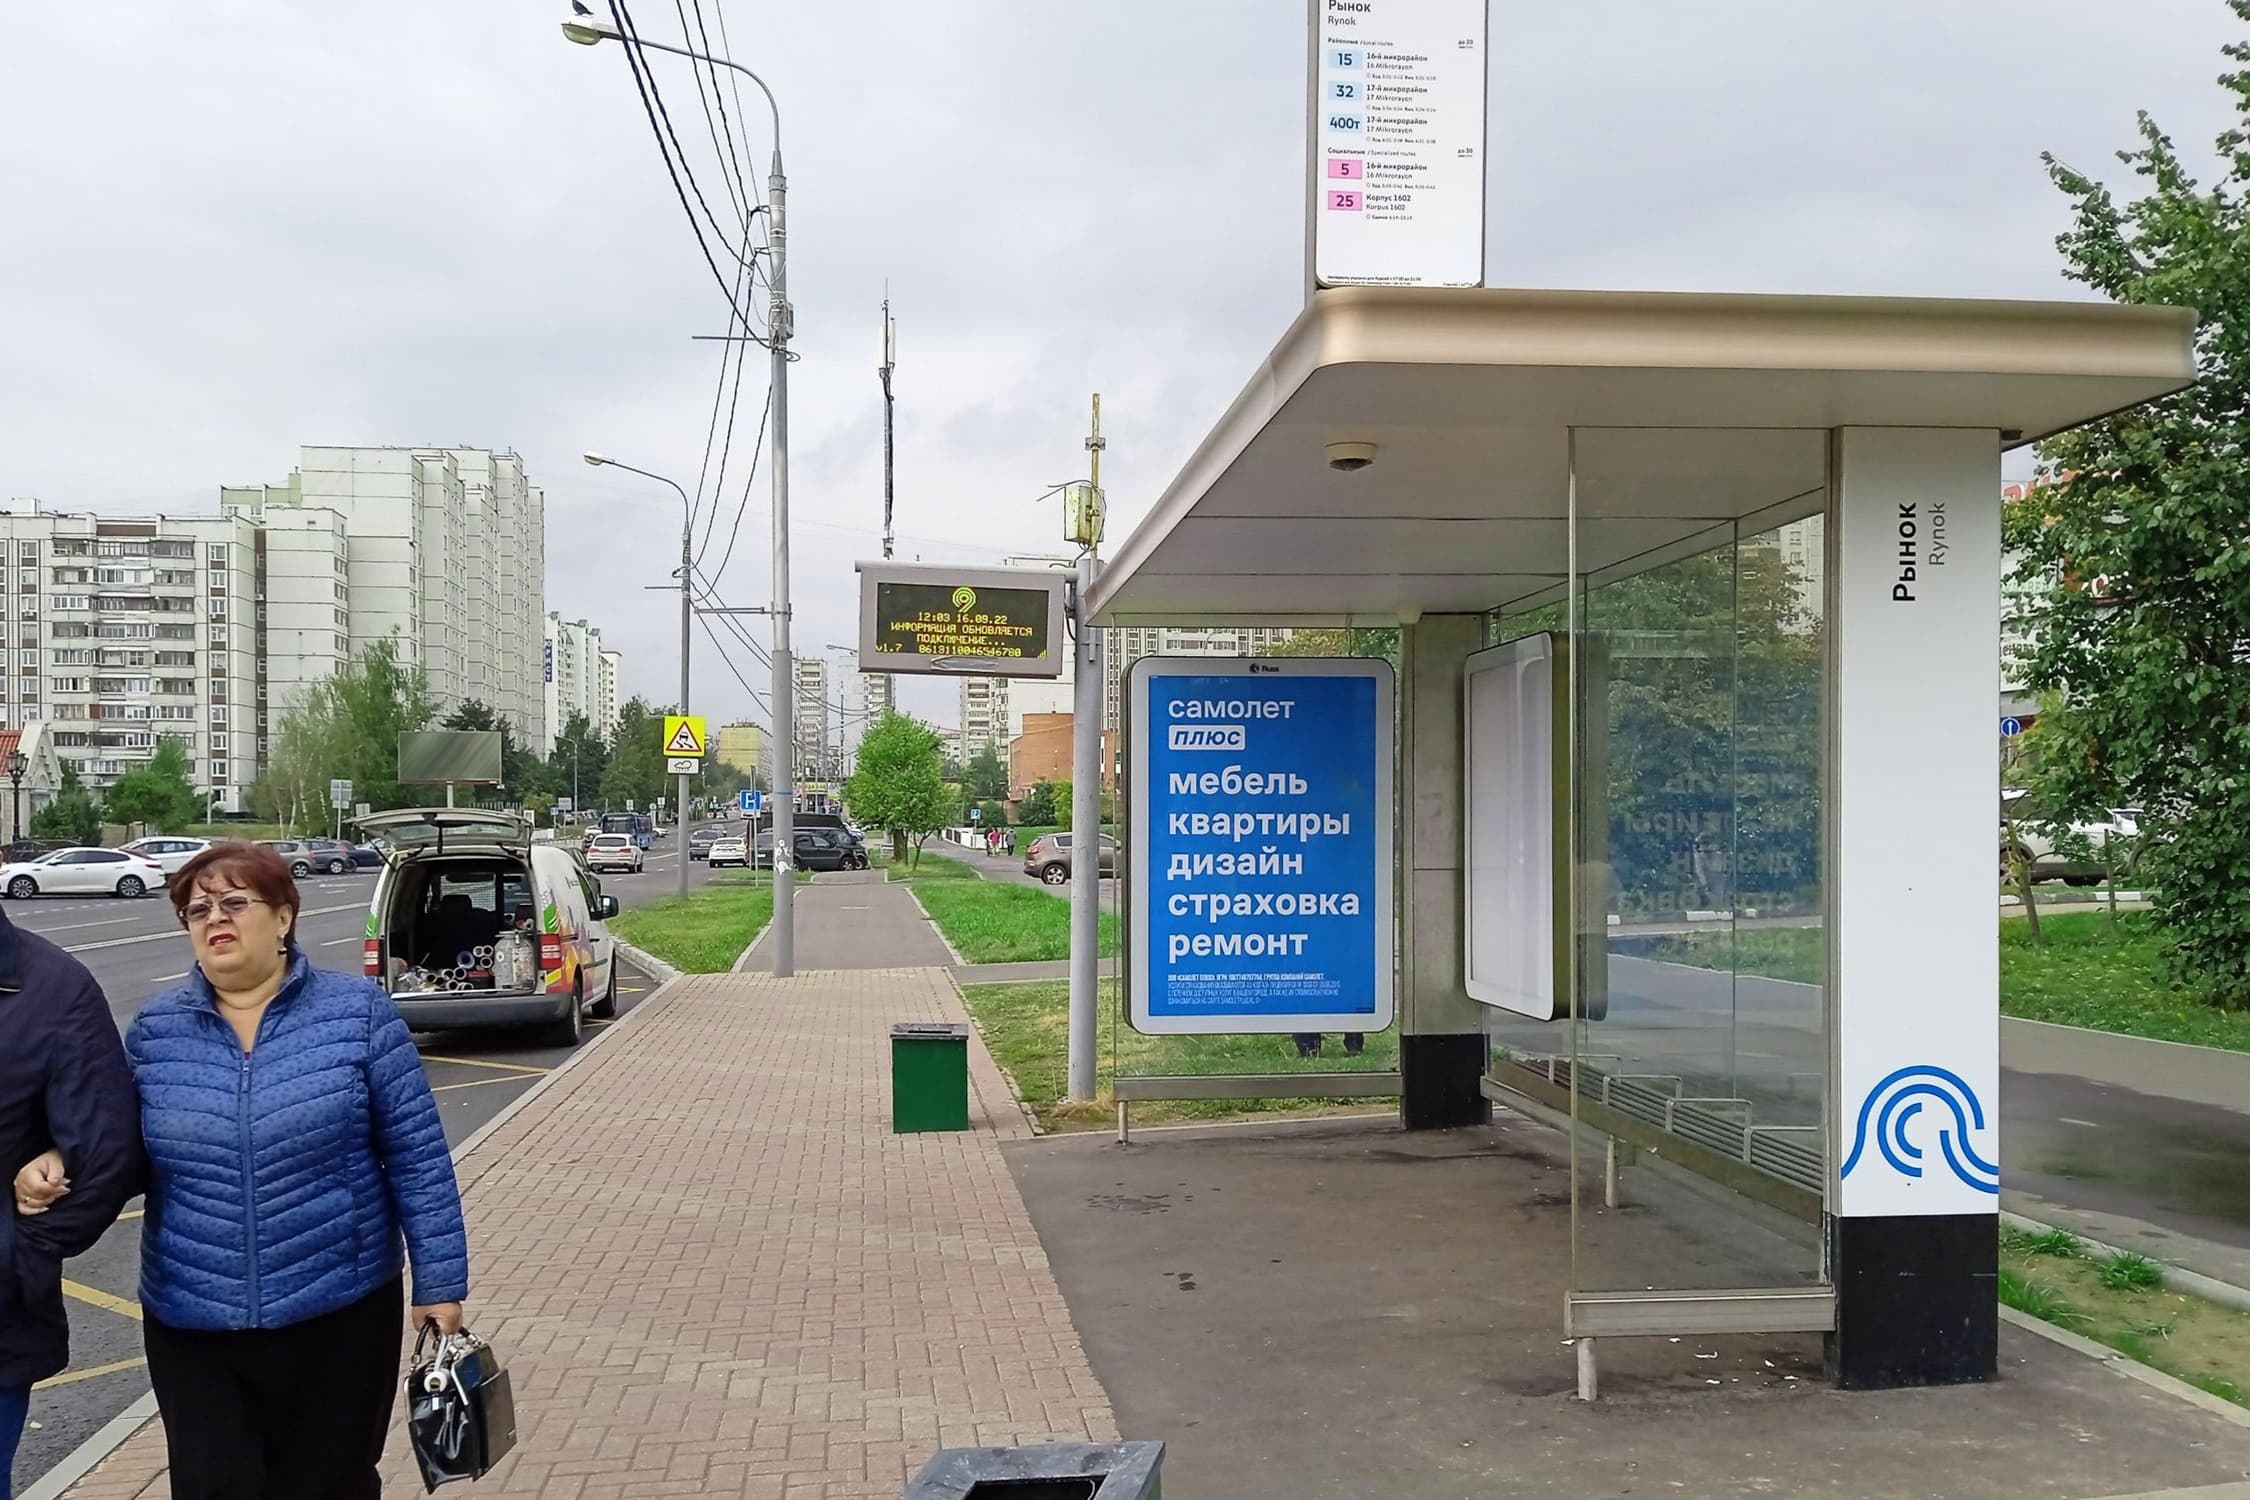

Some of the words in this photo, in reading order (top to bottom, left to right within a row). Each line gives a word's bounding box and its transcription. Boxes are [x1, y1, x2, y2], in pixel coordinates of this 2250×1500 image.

[1328, 0, 1371, 12] Рынок
[1328, 16, 1356, 26] Rynok
[1338, 53, 1353, 66] 15
[1336, 85, 1354, 98] 32
[1330, 117, 1361, 130] 400т
[1341, 163, 1349, 176] 5
[1336, 194, 1354, 207] 25
[1366, 194, 1392, 202] Корпус
[1394, 194, 1412, 202] 1602
[1928, 503, 1949, 565] Rynok
[1893, 502, 1916, 601] Рынок
[918, 612, 950, 621] 12:03
[957, 614, 1008, 625] 16.09.22
[891, 622, 957, 634] ИНФОРМАЦИЯ
[962, 624, 1033, 636] ОБНОВЛЯЕТСЯ
[1168, 700, 1295, 719] самолет
[1174, 731, 1241, 745] плюс
[1169, 765, 1308, 795] мебель
[1169, 812, 1350, 842] квартиры
[1167, 846, 1303, 880] дизайн
[1168, 892, 1360, 923] страховка
[1169, 933, 1308, 964] ремонт
